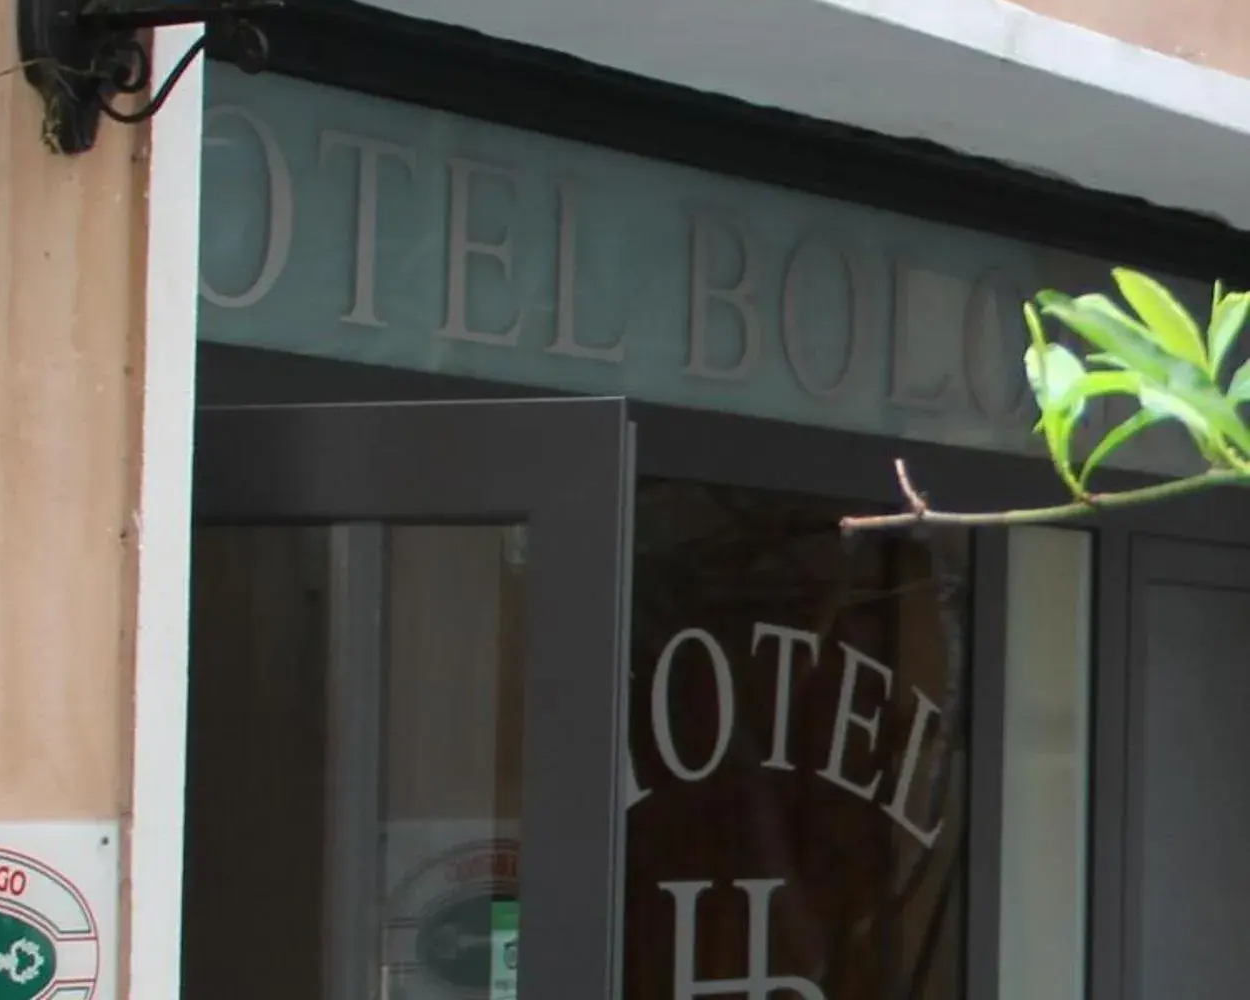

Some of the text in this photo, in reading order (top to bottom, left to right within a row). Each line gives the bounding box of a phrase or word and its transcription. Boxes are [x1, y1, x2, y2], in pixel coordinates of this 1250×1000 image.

[197, 103, 1036, 418] OTEL BOLO
[625, 621, 946, 849] OTEL
